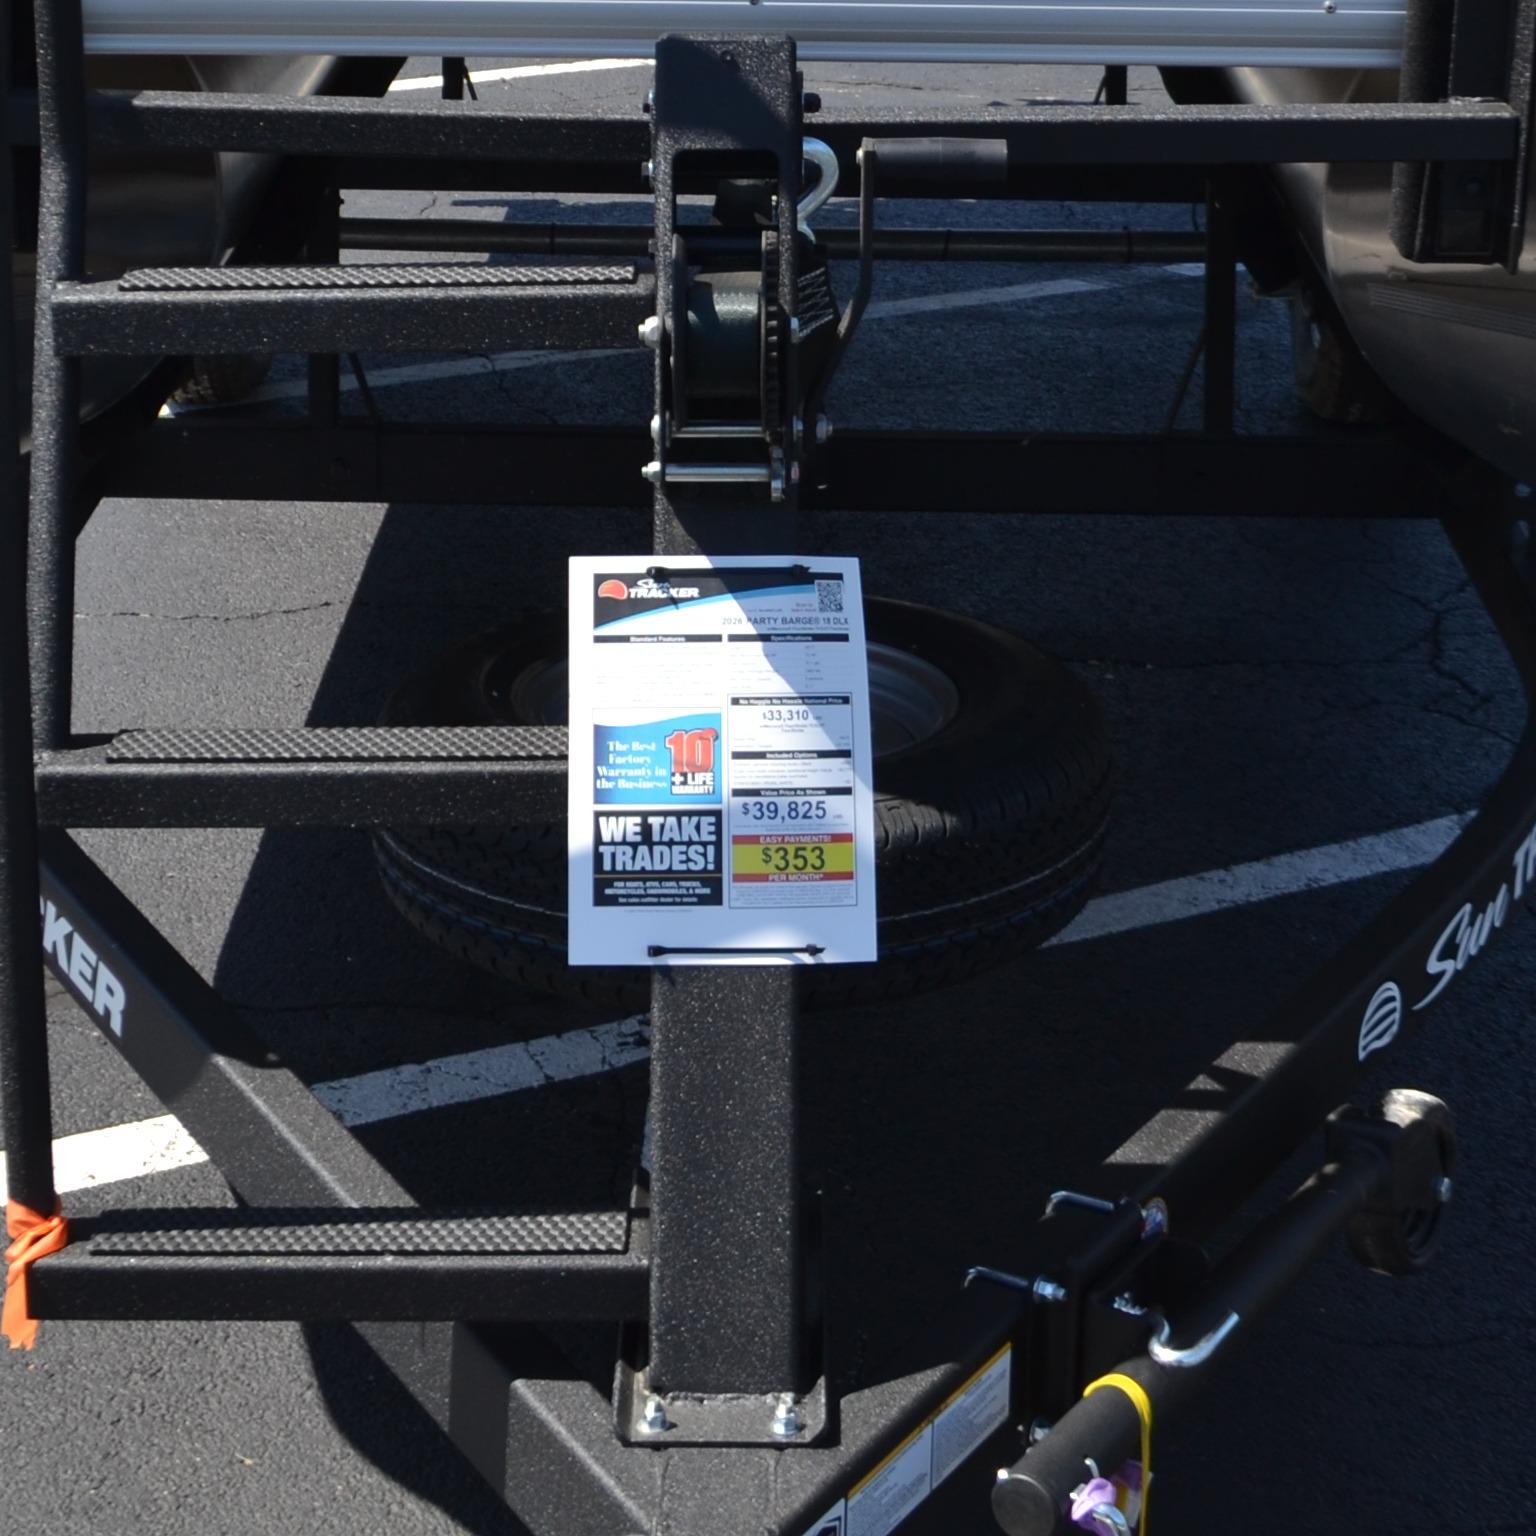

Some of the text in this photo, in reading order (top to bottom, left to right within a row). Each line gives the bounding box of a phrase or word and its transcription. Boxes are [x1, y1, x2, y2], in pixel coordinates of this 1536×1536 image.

[628, 587, 701, 599] TRACKER
[747, 616, 778, 625] PARTY
[762, 709, 809, 723] $33,310
[607, 741, 656, 751] The Best
[596, 778, 616, 789] the
[687, 772, 714, 785] LIFE
[741, 800, 827, 823] $39,825
[598, 816, 717, 842] WE TAKE
[598, 844, 715, 871] TRADES!
[761, 846, 826, 872] $353
